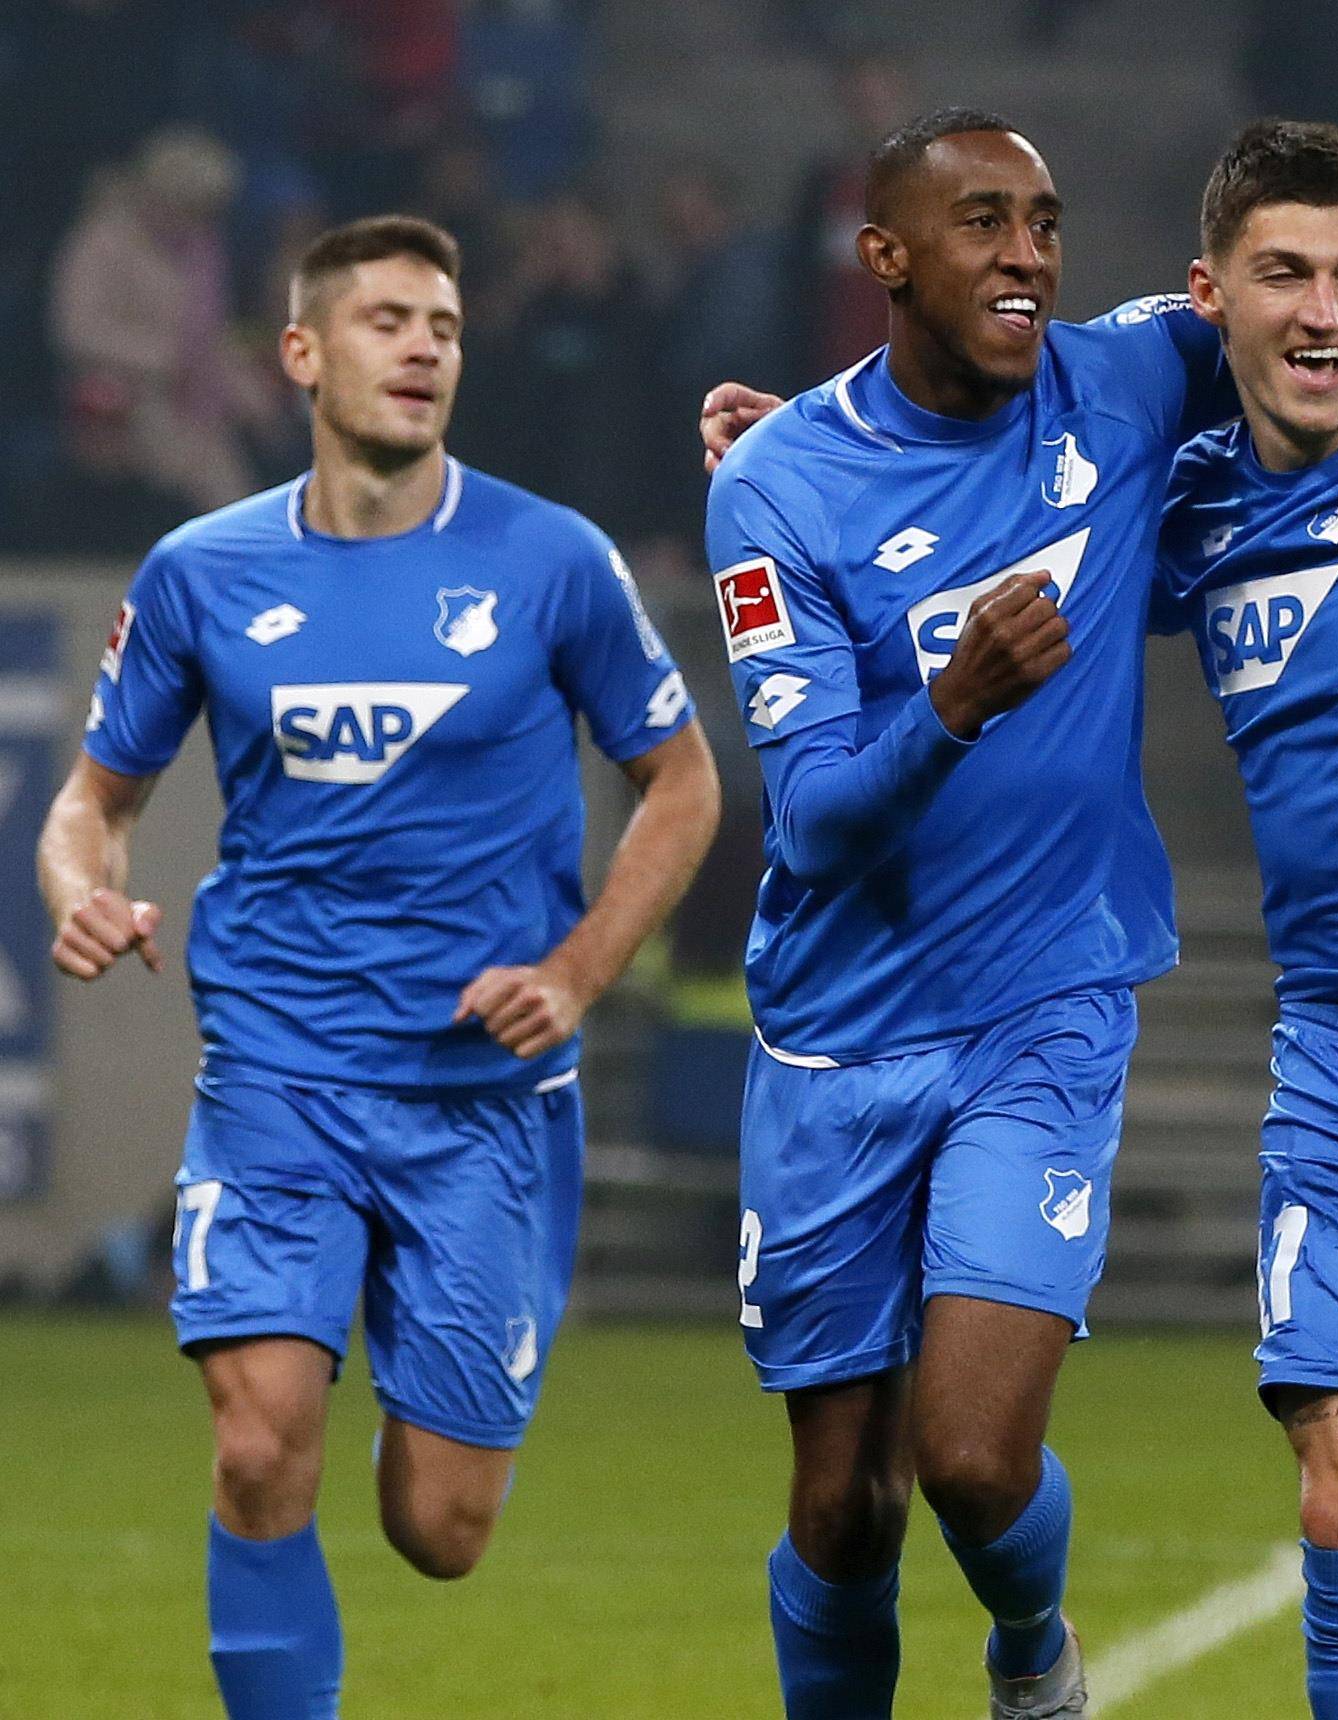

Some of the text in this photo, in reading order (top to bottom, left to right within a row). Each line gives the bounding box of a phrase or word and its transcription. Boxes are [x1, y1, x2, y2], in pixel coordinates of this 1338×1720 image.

[1209, 595, 1304, 676] SAP
[280, 706, 413, 761] SAP
[172, 1181, 224, 1292] 7
[1256, 1204, 1309, 1341] 1
